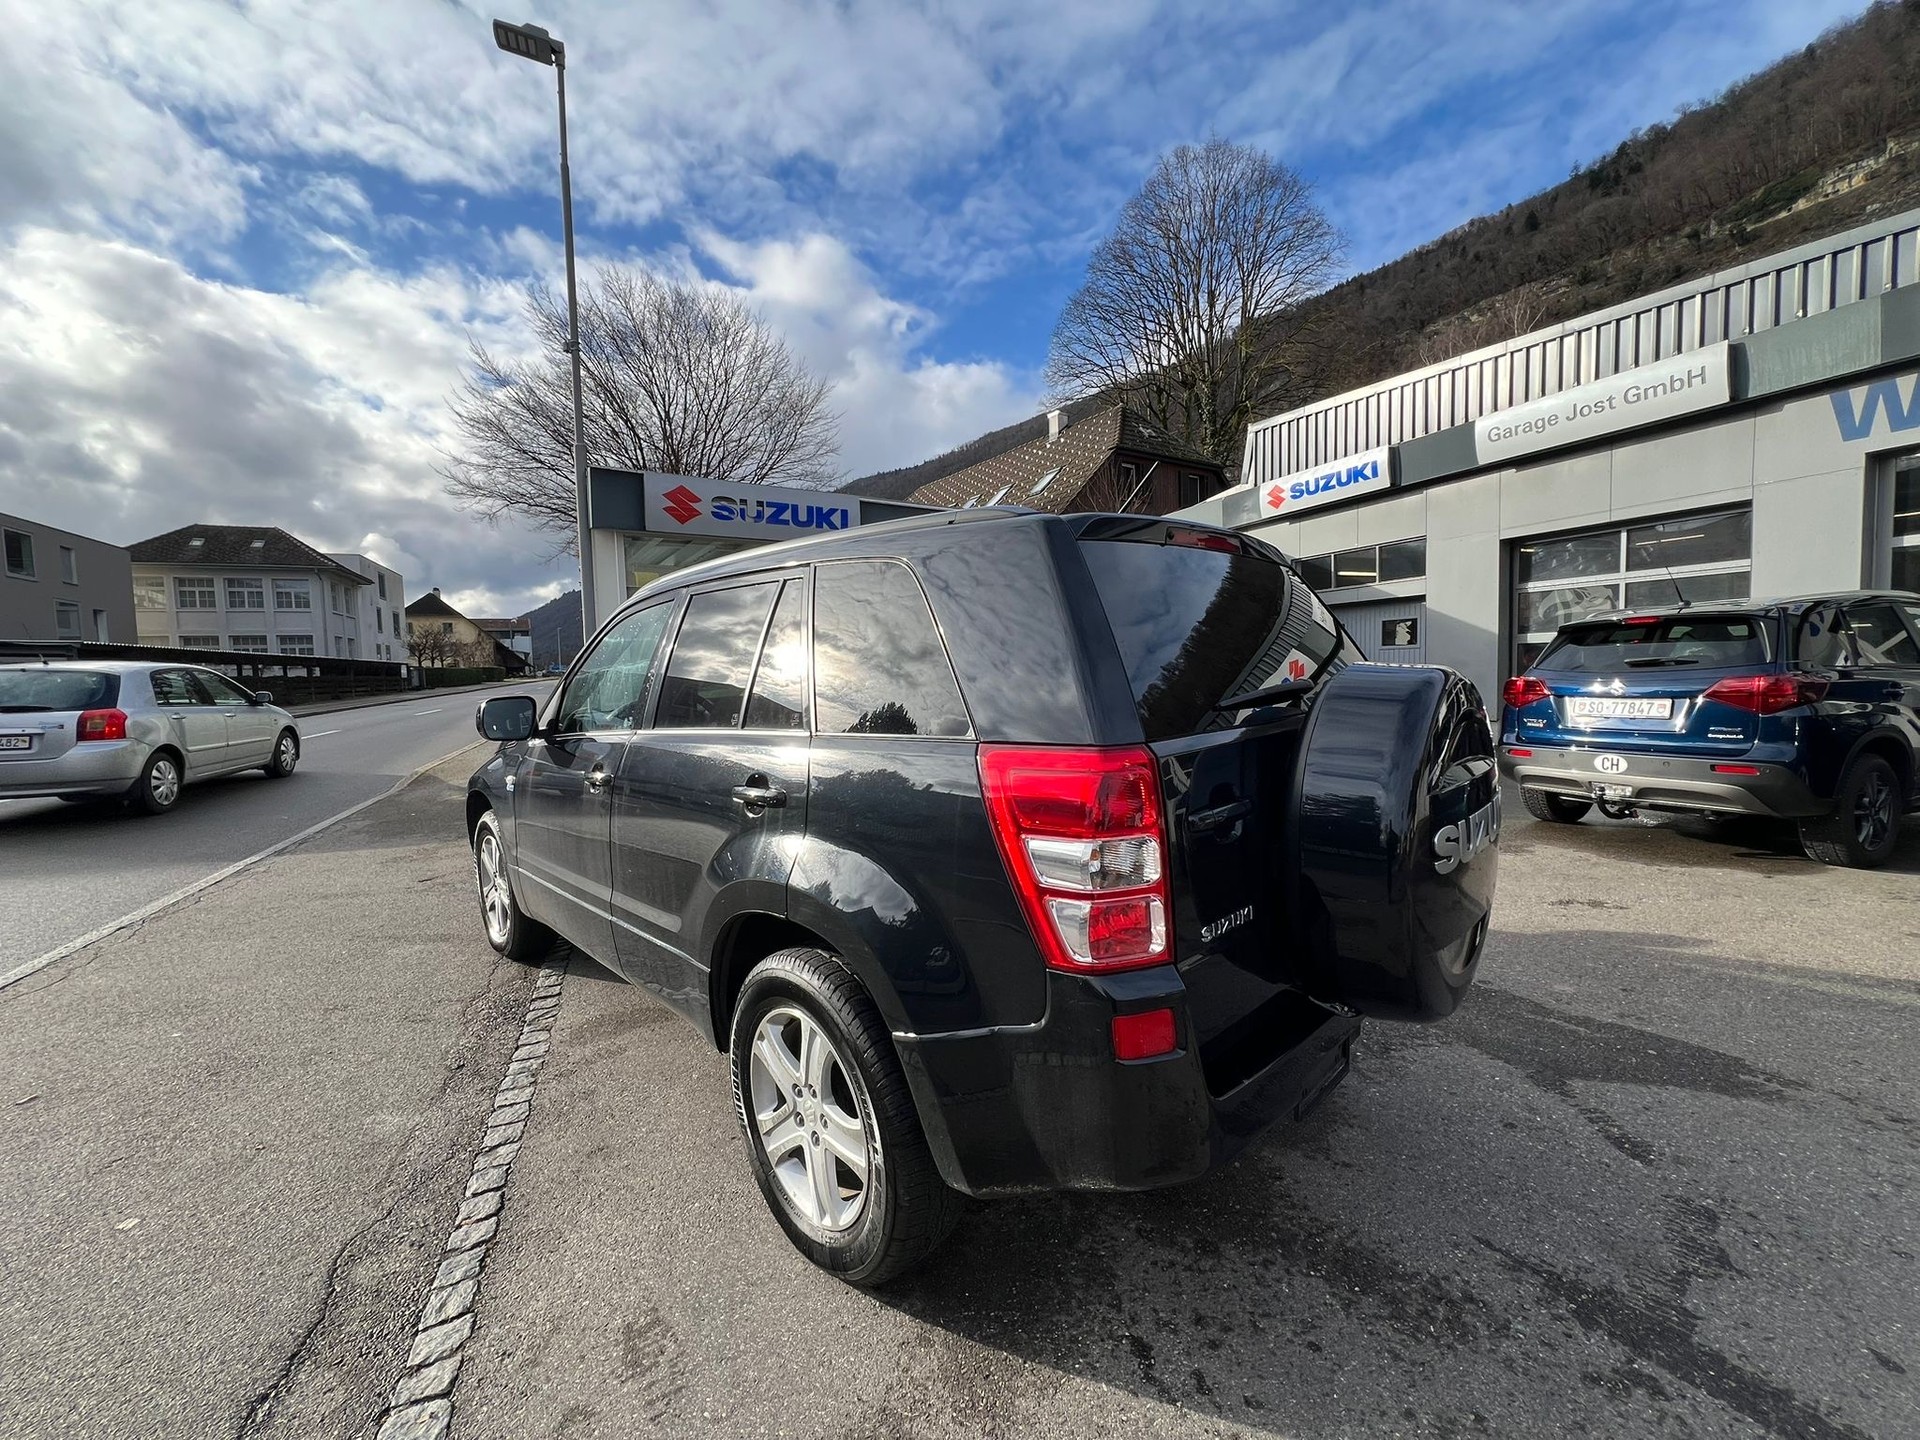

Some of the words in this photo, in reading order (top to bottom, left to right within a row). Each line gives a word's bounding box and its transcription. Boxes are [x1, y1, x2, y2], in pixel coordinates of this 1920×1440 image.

[1487, 413, 1559, 443] Garage
[1565, 394, 1617, 422] Jost
[1623, 365, 1707, 405] GmbH
[1289, 460, 1379, 500] SUZUKI
[711, 496, 849, 530] SUZUKI
[1601, 756, 1620, 772] CH
[1201, 905, 1253, 943] SUZUKI
